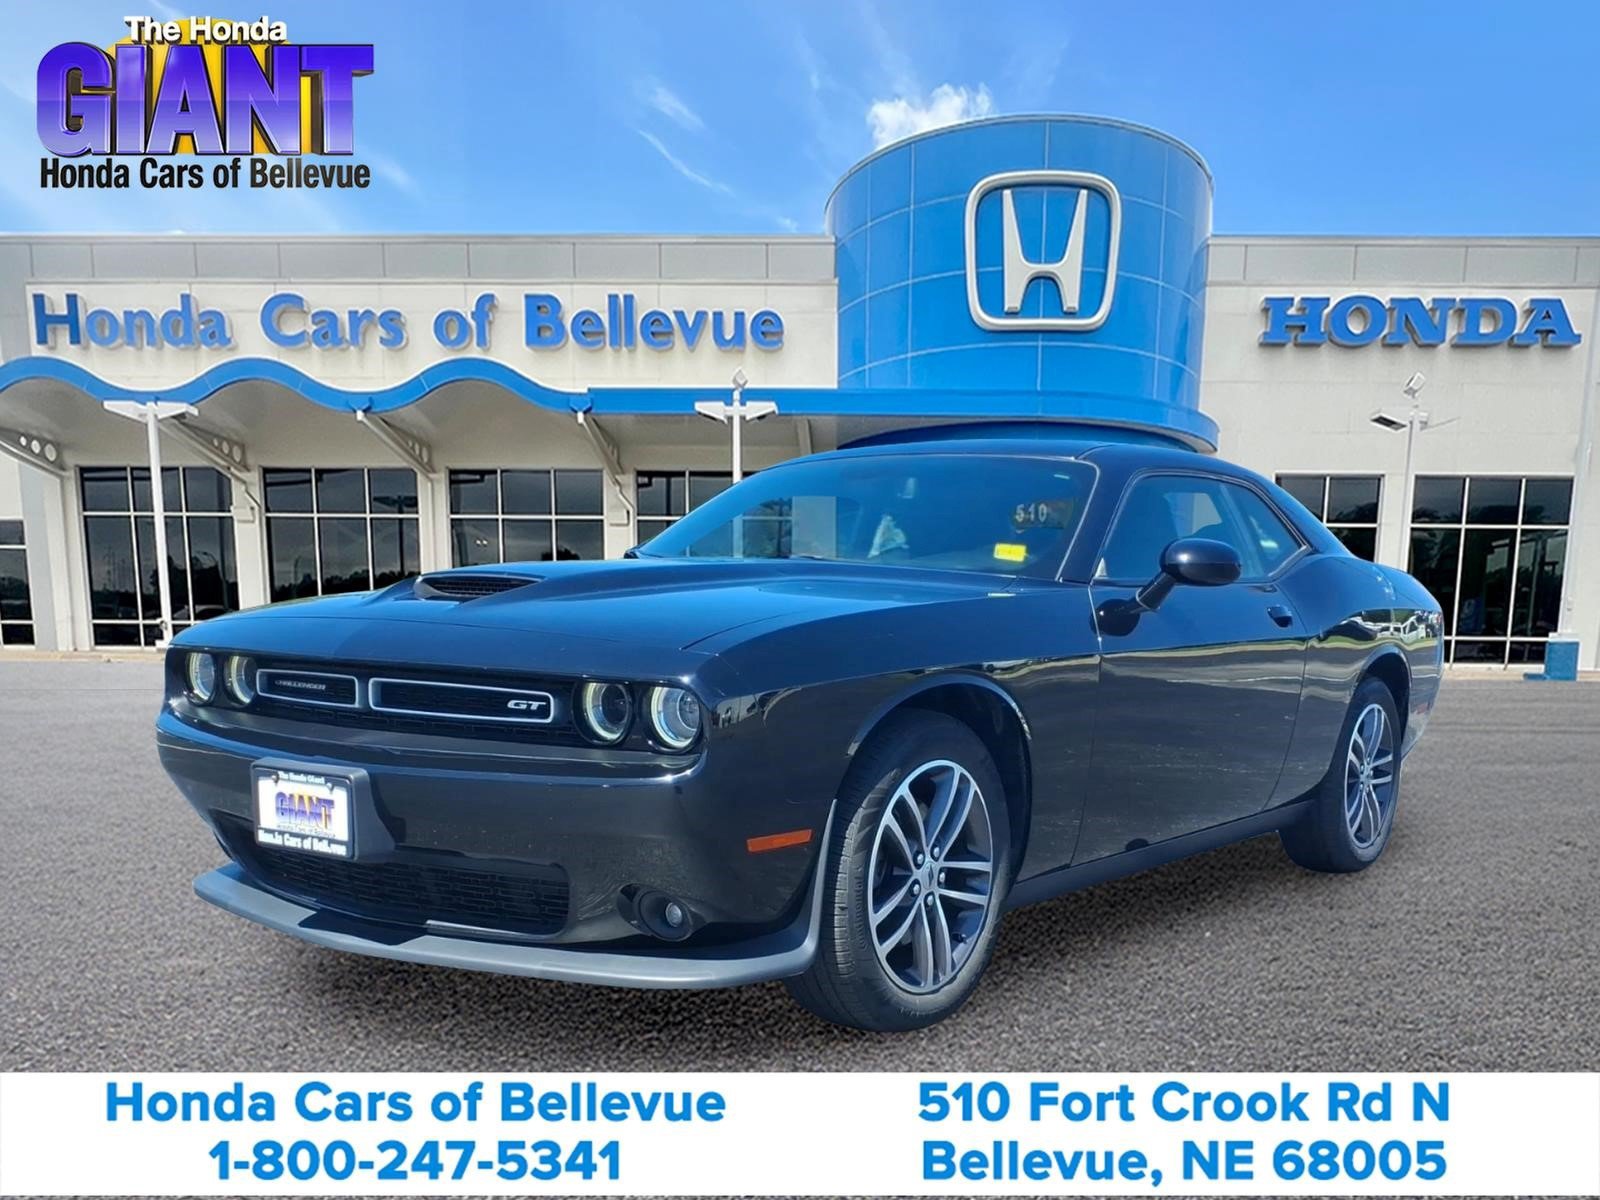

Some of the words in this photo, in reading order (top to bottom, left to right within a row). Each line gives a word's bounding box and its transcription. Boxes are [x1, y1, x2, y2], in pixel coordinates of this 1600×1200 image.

[33, 292, 233, 350] Honda
[260, 292, 405, 350] Cars
[433, 293, 496, 350] of
[524, 293, 785, 351] Bellevue
[1258, 295, 1582, 347] HONDA
[1015, 503, 1048, 522] 510
[507, 699, 546, 711] GT
[277, 771, 289, 780] The
[275, 791, 335, 829] GIANT
[284, 833, 303, 849] Cars
[303, 837, 312, 850] of
